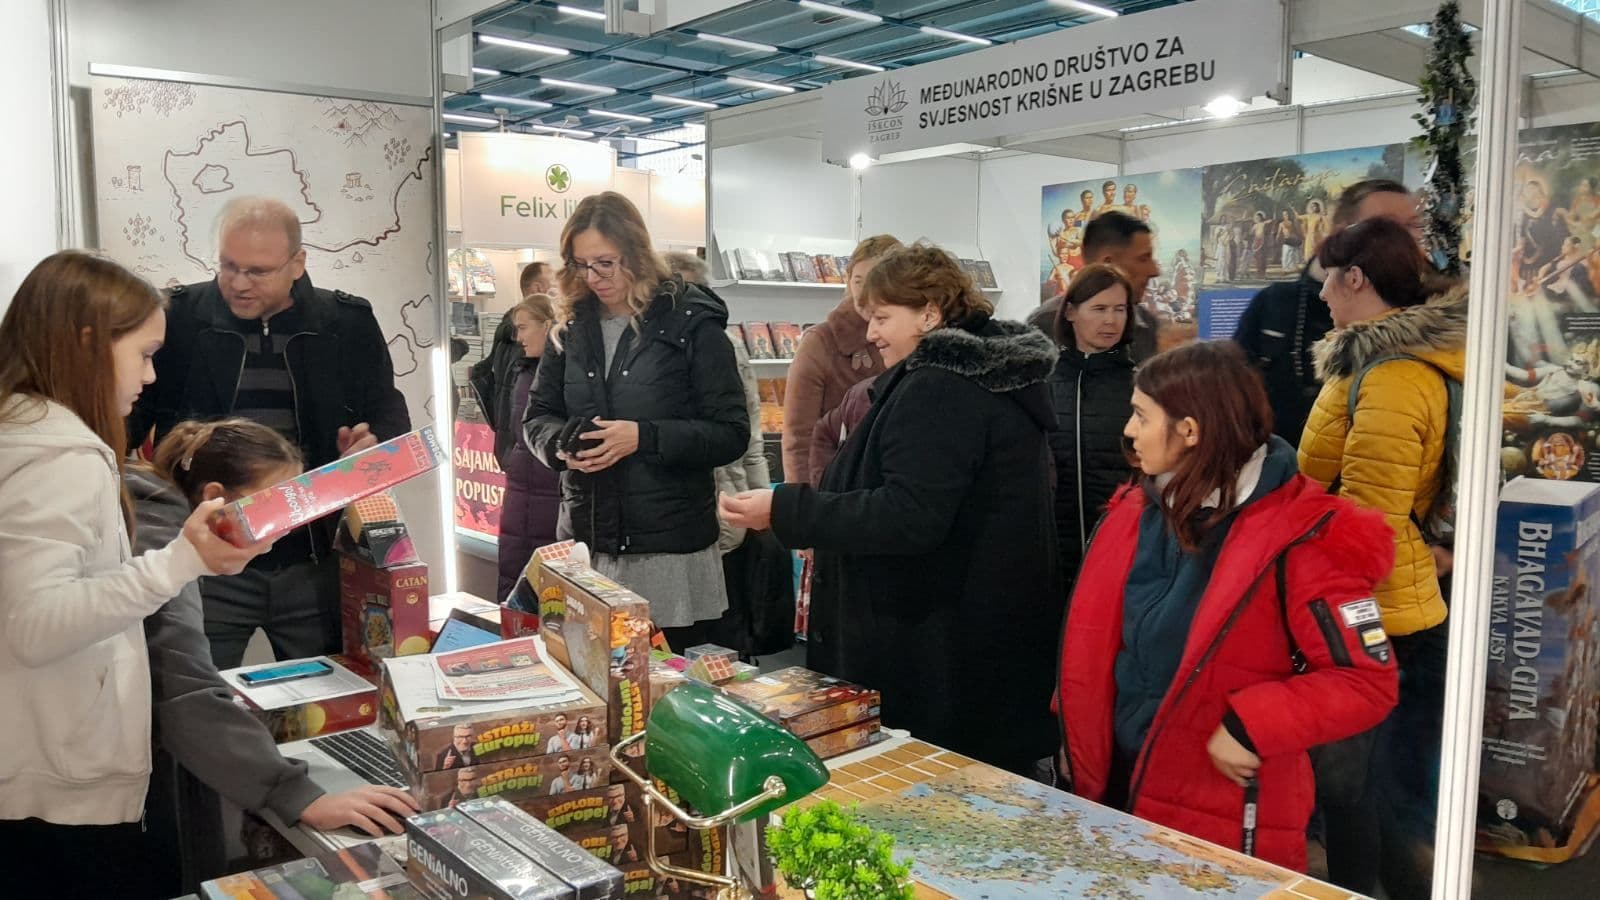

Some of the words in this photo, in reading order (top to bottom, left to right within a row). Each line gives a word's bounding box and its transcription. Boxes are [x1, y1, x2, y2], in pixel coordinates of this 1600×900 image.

[920, 62, 1049, 104] MEĐUNARODNO
[1054, 42, 1149, 79] DRUŠTVO
[1155, 35, 1185, 60] ZA
[918, 96, 1012, 129] SVJESNOST
[1017, 82, 1083, 112] KRIŠNE
[1090, 79, 1103, 99] U
[1108, 59, 1216, 97] ZAGREBU
[500, 195, 558, 219] Felix
[396, 576, 427, 588] CATAN
[1491, 576, 1510, 624] KAKVA
[1488, 627, 1507, 664] JEST
